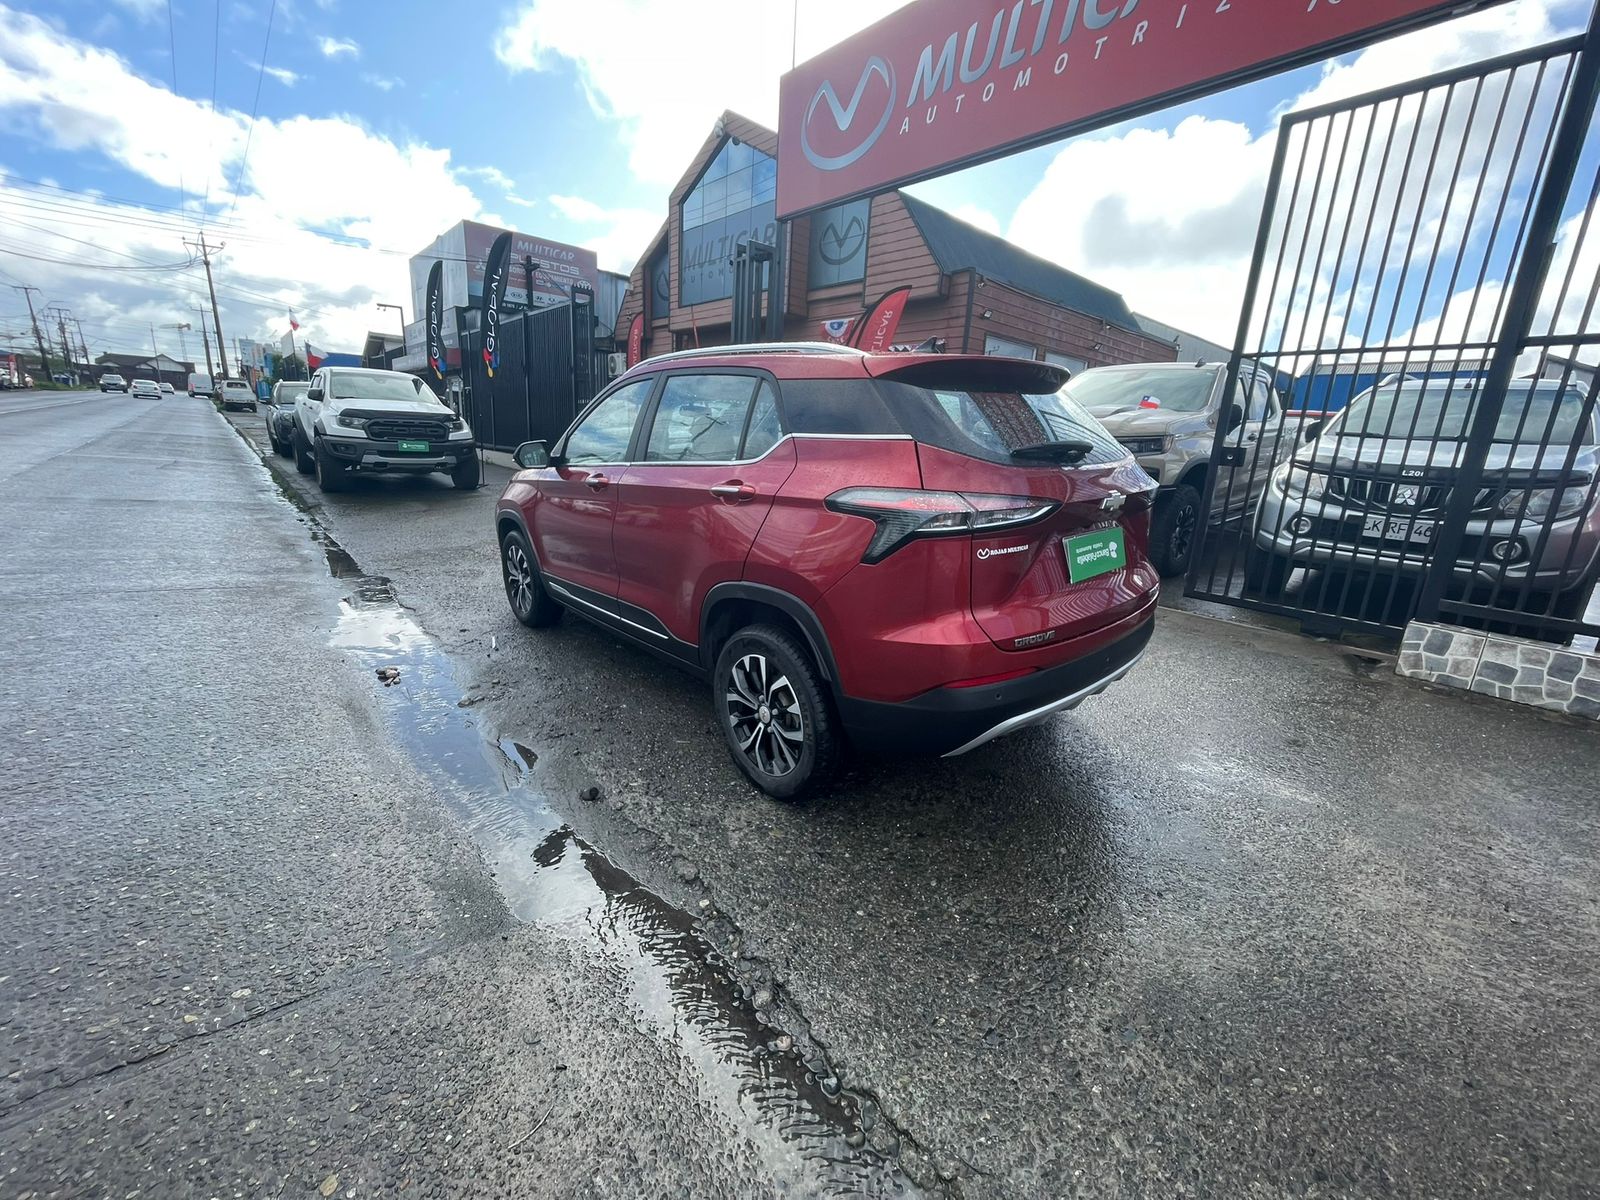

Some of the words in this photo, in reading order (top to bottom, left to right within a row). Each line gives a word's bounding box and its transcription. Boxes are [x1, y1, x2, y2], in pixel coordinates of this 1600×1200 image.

[516, 240, 576, 262] MULTICAR
[486, 267, 502, 353] GLOBAL
[371, 425, 445, 433] FORD
[1014, 630, 1055, 646] GROOVE
